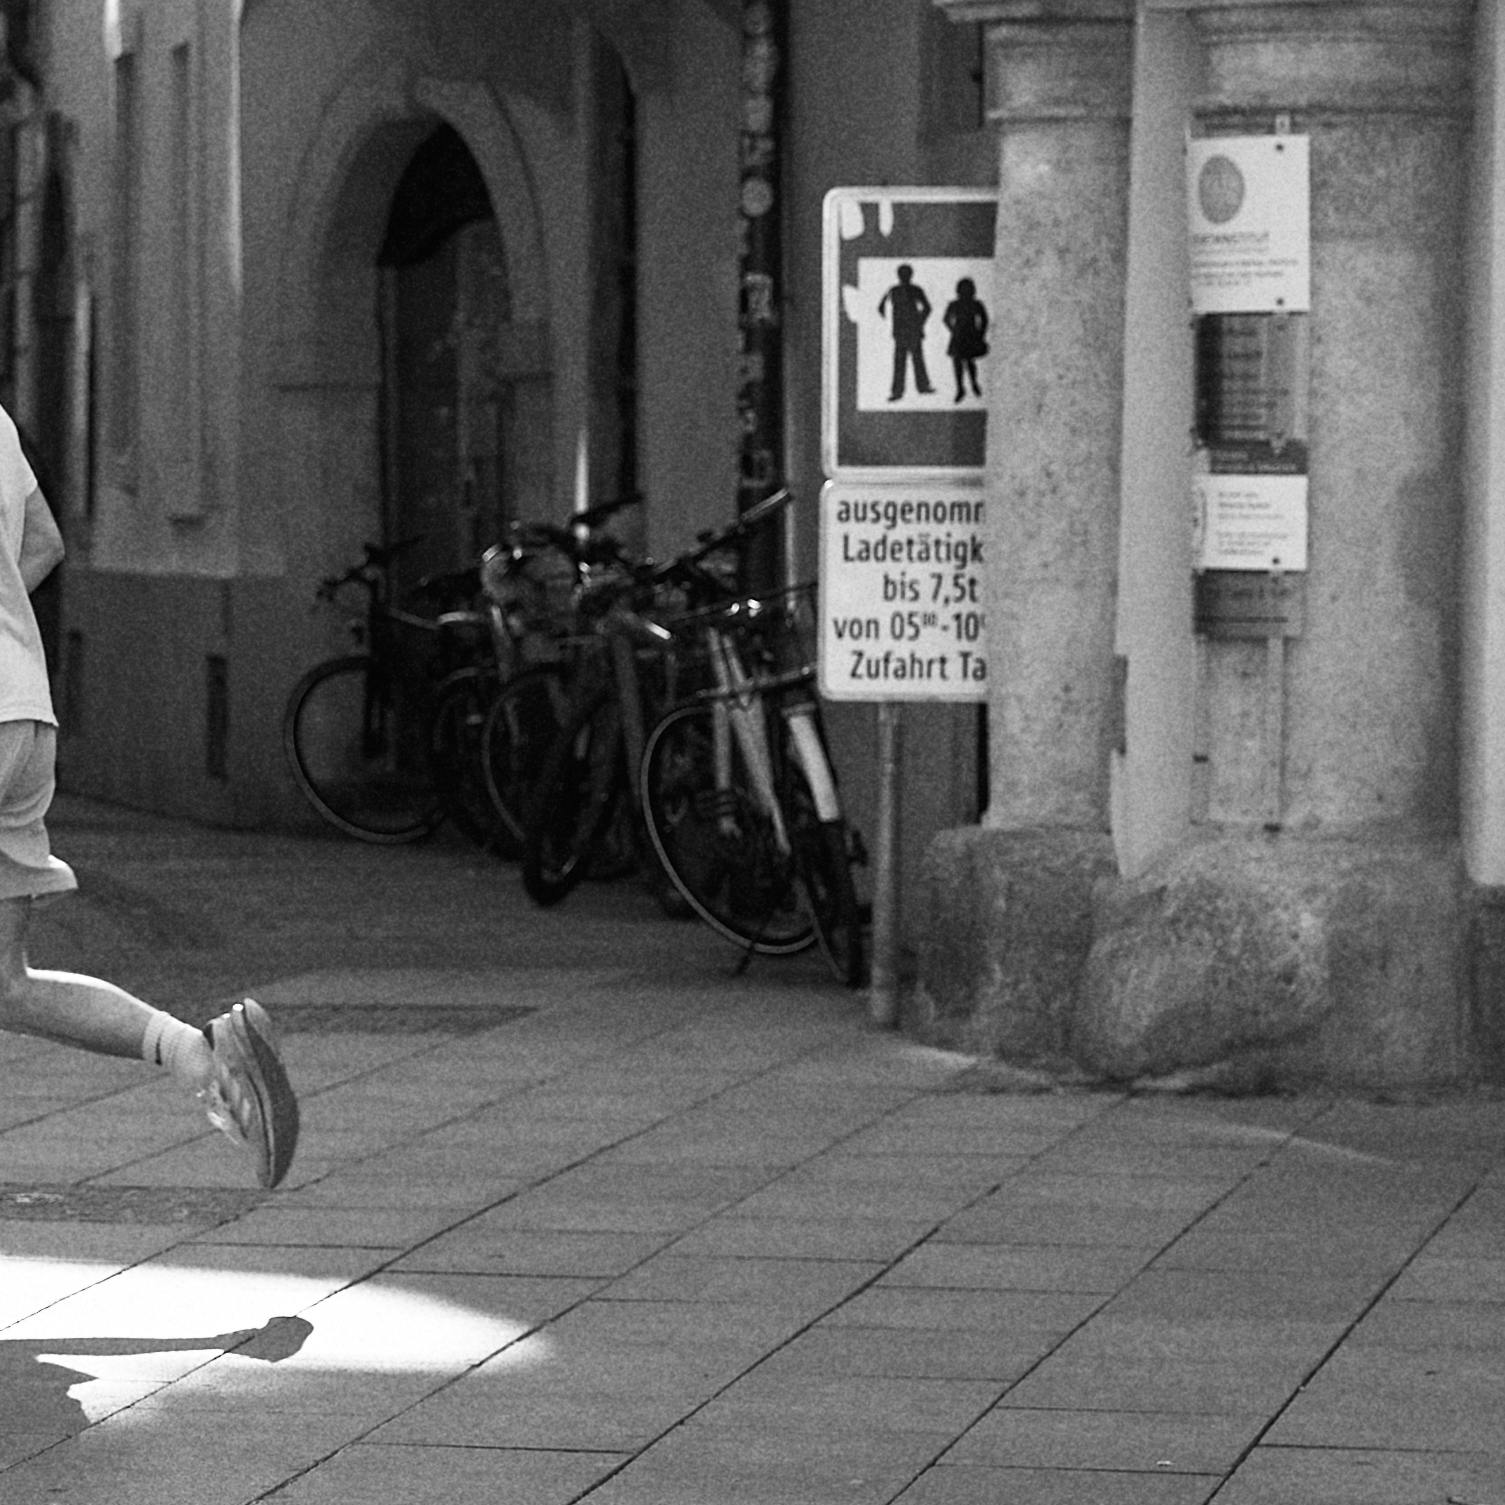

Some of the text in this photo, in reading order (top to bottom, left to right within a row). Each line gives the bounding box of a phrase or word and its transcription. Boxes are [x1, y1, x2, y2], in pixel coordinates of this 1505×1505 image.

[843, 532, 985, 570] Ladetätigk
[883, 571, 978, 607] bis 7,5t
[833, 617, 880, 640] von
[850, 649, 987, 682] Zufahrt Ta
